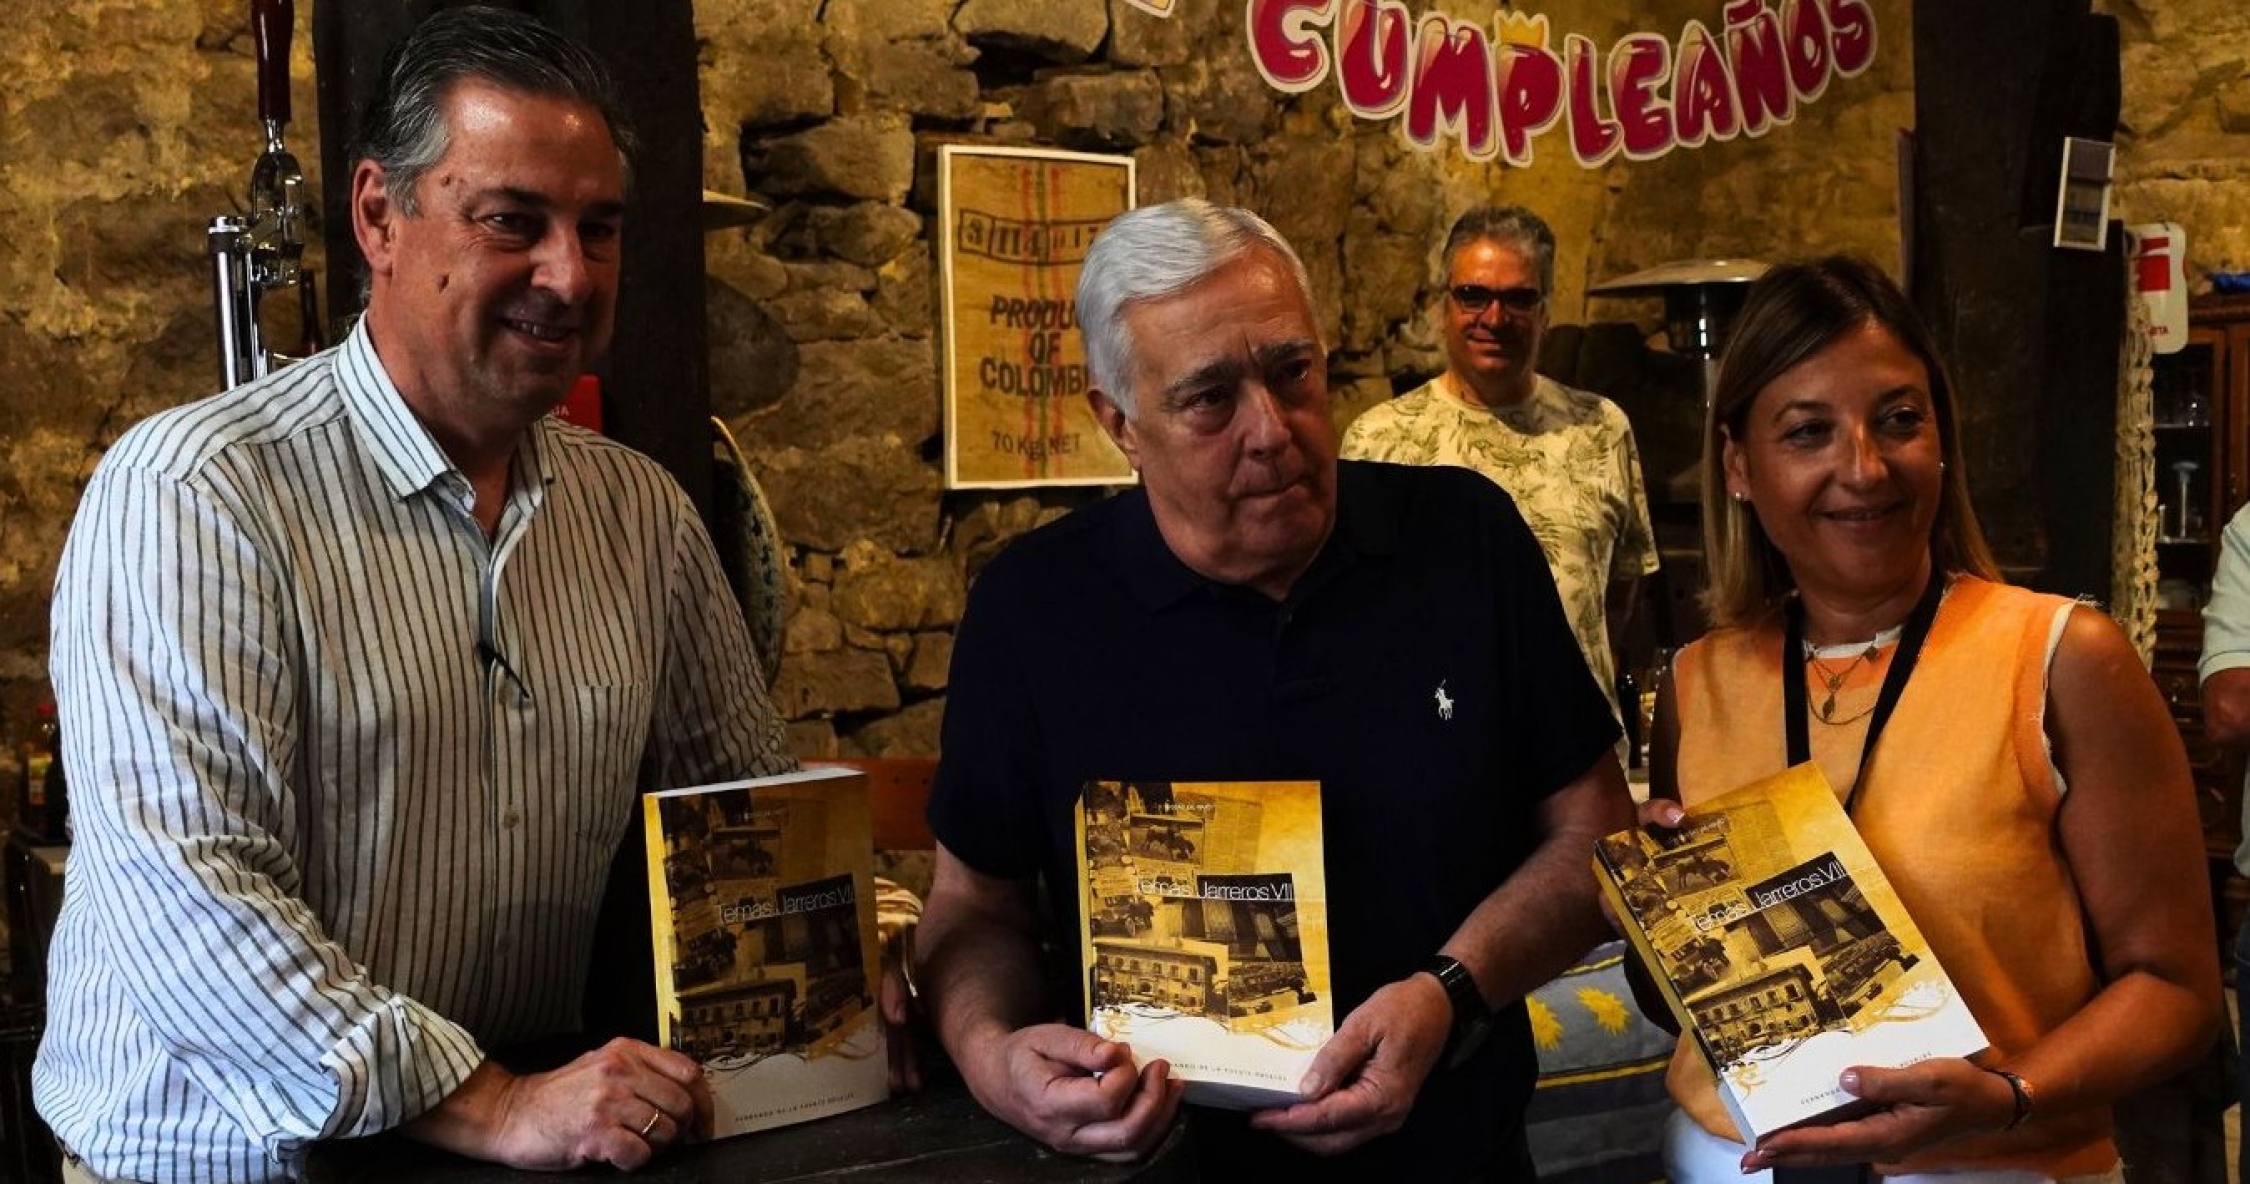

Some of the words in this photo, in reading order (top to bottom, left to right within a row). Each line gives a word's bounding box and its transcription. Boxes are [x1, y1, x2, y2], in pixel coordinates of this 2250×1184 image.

[1247, 0, 1878, 166] CUMPLEAÑOS
[990, 295, 1080, 330] PRODU
[1030, 331, 1062, 364] OF
[980, 357, 1090, 397] COLOMBI
[1136, 878, 1191, 898] Temas
[1197, 881, 1269, 900] Jarreros
[1690, 903, 1749, 932] Temas
[1751, 872, 1825, 912] Jarreros
[717, 901, 773, 923] Temas
